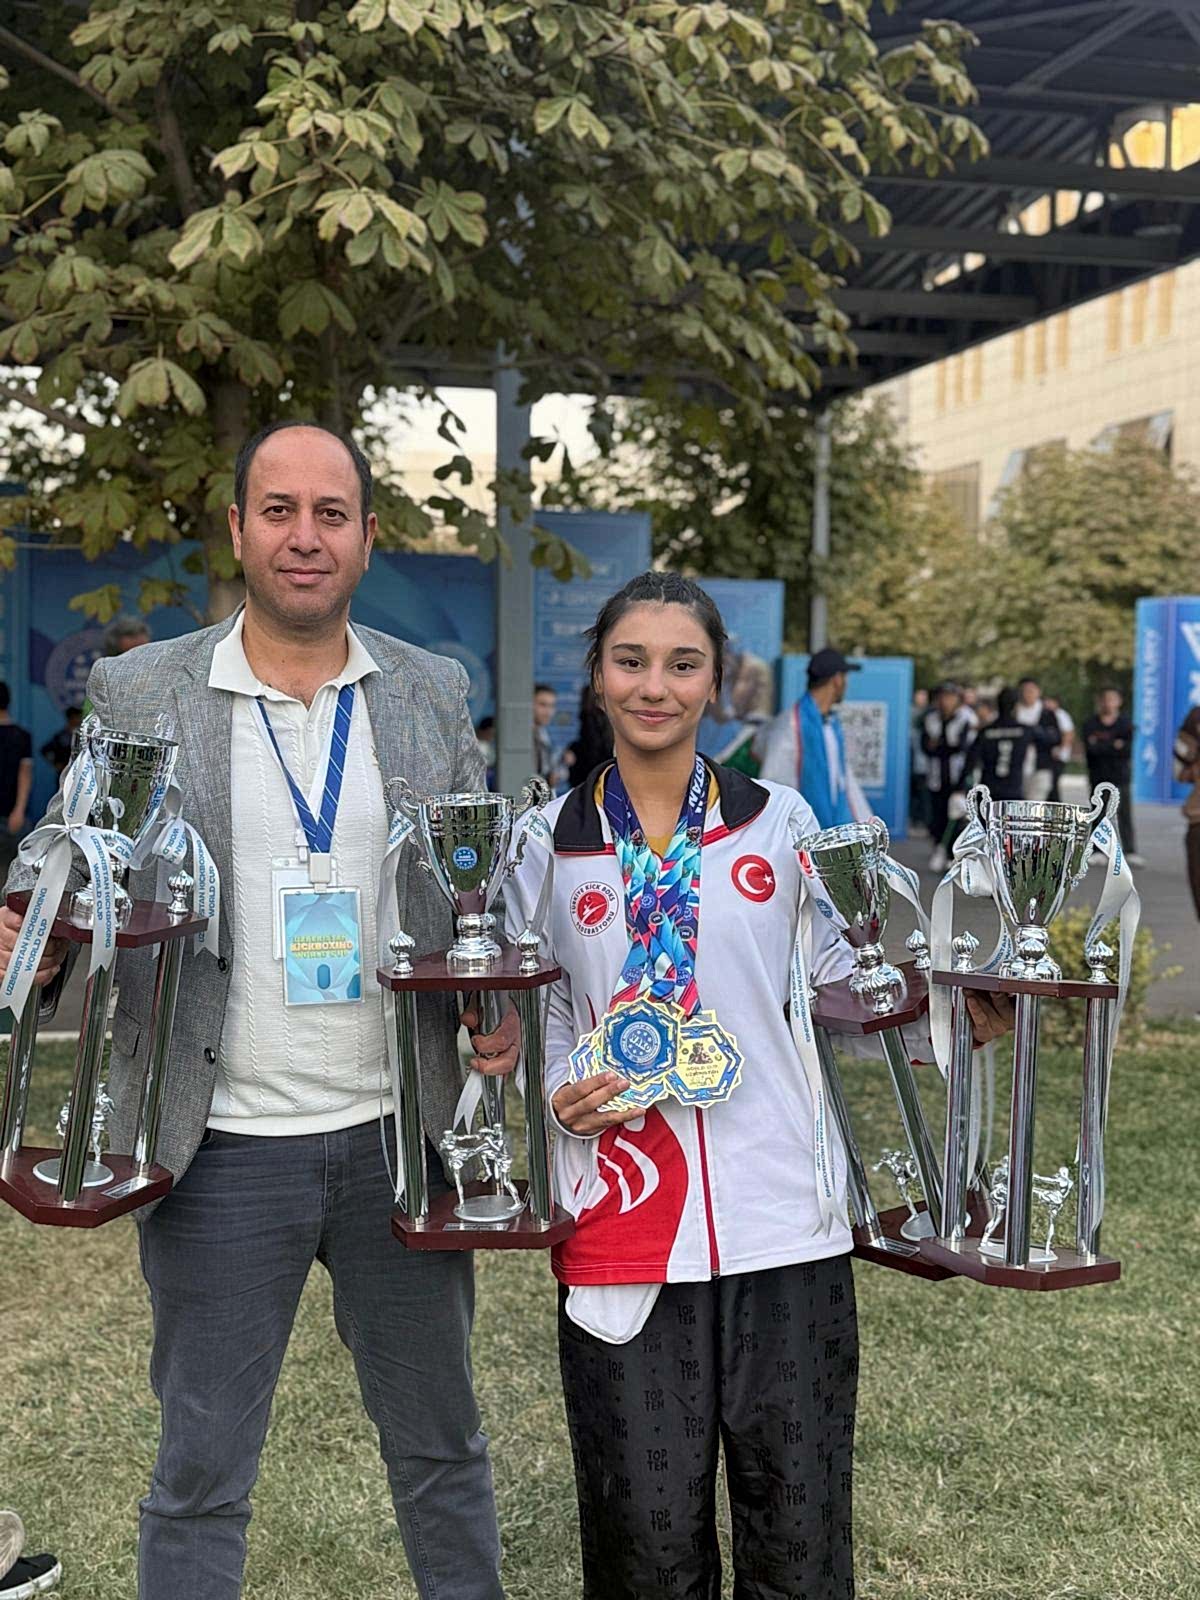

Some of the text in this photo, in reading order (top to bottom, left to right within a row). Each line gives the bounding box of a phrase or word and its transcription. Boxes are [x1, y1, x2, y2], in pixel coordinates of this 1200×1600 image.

[67, 764, 90, 817] UZBEKISTAN
[93, 863, 103, 898] WORLD
[601, 886, 616, 902] BOKS
[6, 887, 48, 996] UZBEKISTAN KICKBOXING
[25, 918, 47, 972] WORLD CUP
[800, 992, 812, 1043] KICKBOXING
[678, 1305, 695, 1314] TOP
[771, 1302, 790, 1313] TOP
[679, 1314, 696, 1325] TEN
[643, 1342, 661, 1352] TEN
[608, 1358, 624, 1370] TOP
[680, 1360, 699, 1370] TOP
[776, 1361, 796, 1372] TOP
[608, 1370, 625, 1381] TEN
[681, 1369, 700, 1380] TEN
[778, 1371, 798, 1383] TEN
[644, 1389, 664, 1401] TOP
[645, 1400, 665, 1412] TEN
[684, 1416, 704, 1427] TOP
[685, 1427, 705, 1439] TEN
[782, 1421, 802, 1434] TOP
[611, 1427, 628, 1440] TEN
[783, 1433, 803, 1444] TEN
[647, 1449, 667, 1460] TOP
[647, 1460, 668, 1471] TEN
[785, 1483, 806, 1495] TOP
[786, 1494, 806, 1506] TEN
[650, 1509, 671, 1521] TOP
[651, 1520, 672, 1531] TEN
[786, 1540, 807, 1551] TOP
[787, 1551, 808, 1562] TEN
[655, 1567, 676, 1577] TOP
